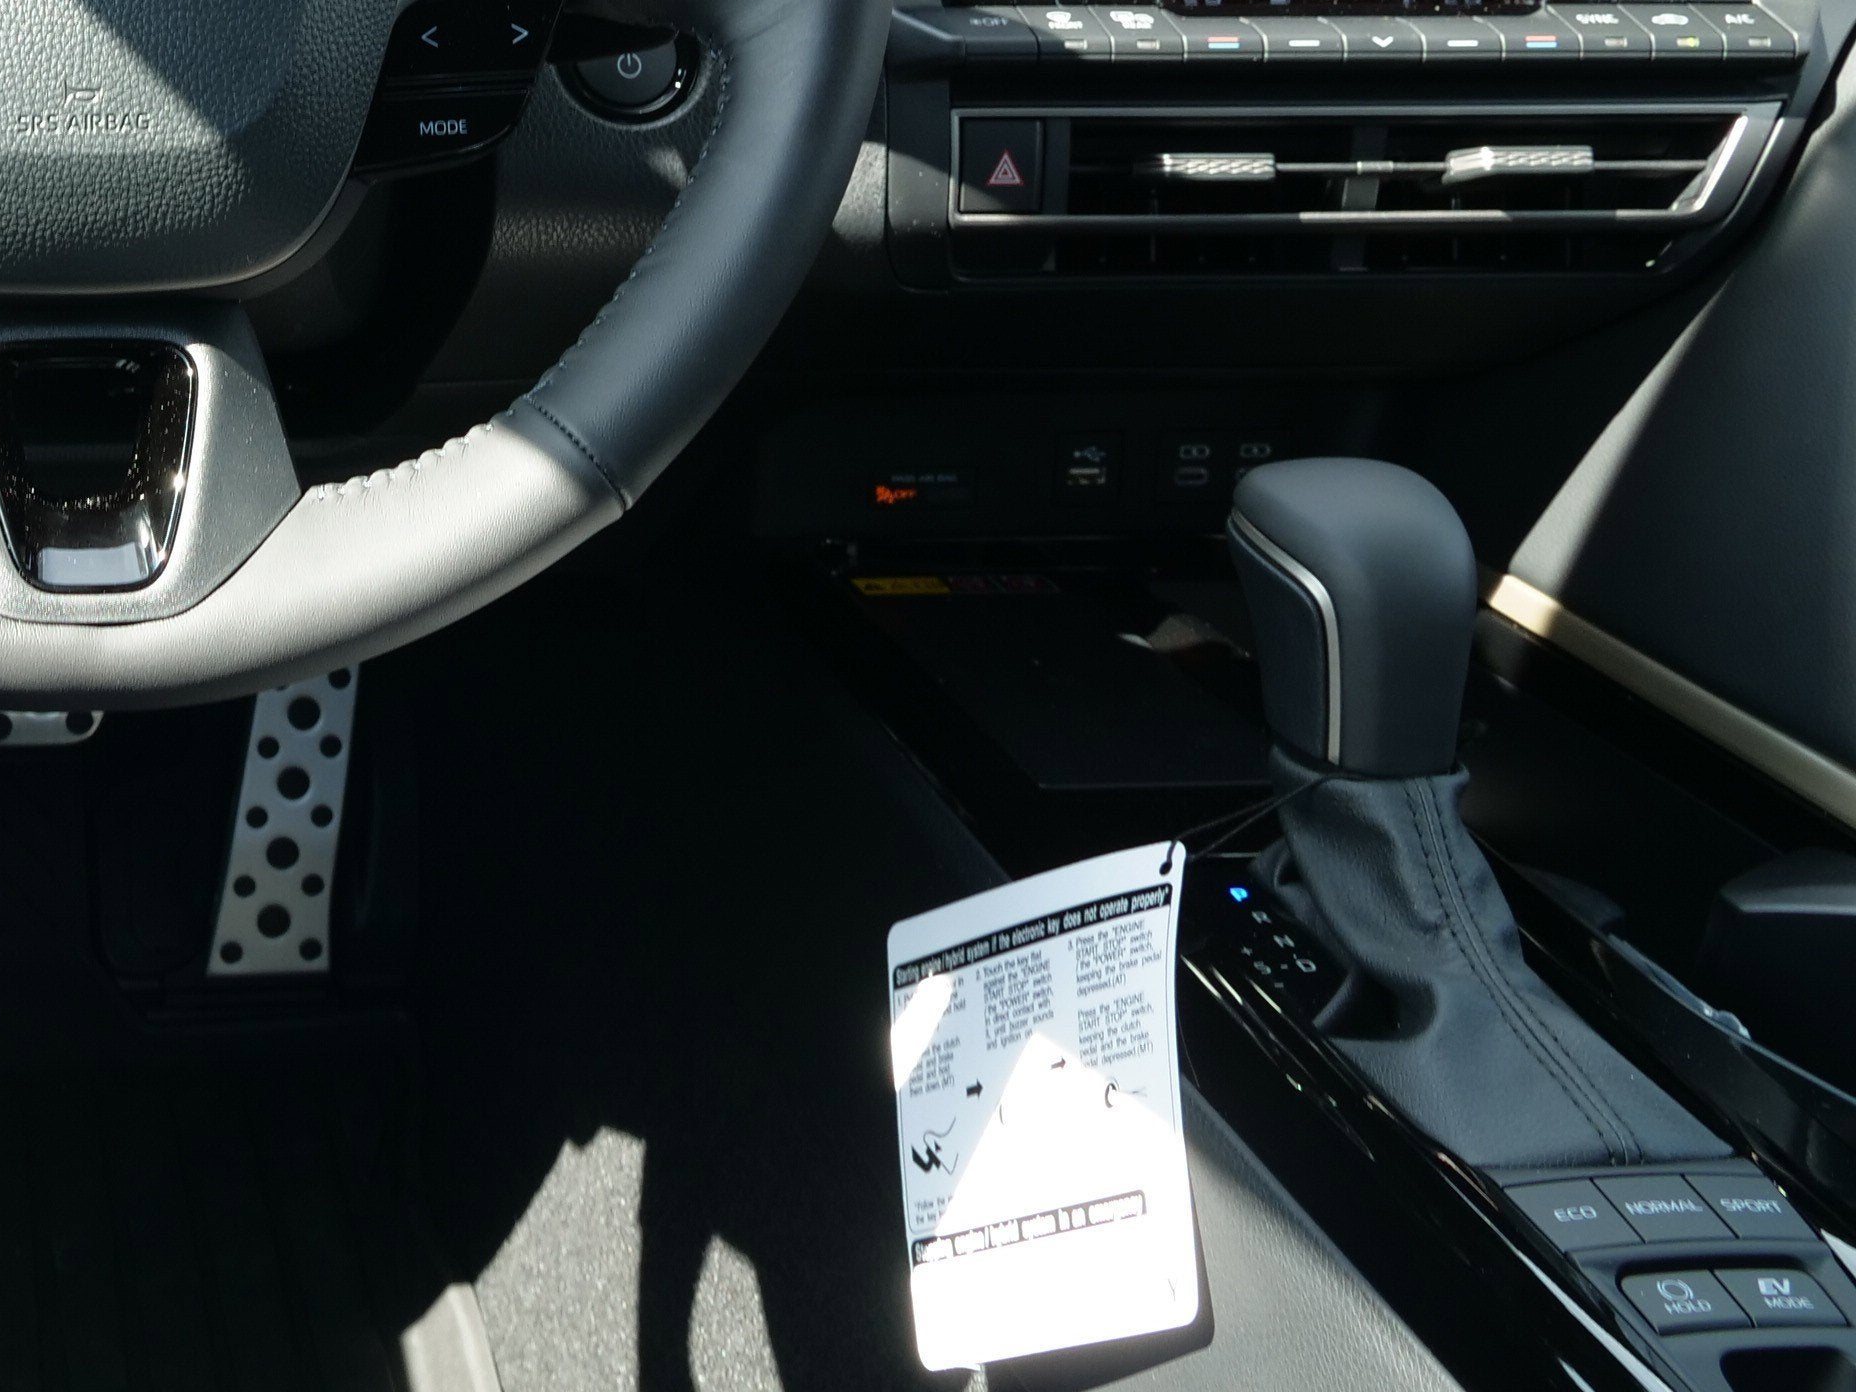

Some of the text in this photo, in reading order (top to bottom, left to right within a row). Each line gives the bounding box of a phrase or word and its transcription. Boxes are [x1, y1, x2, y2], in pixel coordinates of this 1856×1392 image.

[17, 111, 151, 134] SRS AIRBAG
[418, 119, 469, 137] MODE
[895, 964, 919, 987] Starting
[966, 940, 990, 965] system
[998, 933, 1011, 951] the
[1012, 921, 1045, 947] electronic
[1047, 916, 1061, 936] key
[1064, 911, 1082, 929] does
[1084, 906, 1098, 923] not
[1100, 897, 1129, 920] operate
[1075, 934, 1095, 948] Press
[1097, 929, 1109, 941] the
[1075, 945, 1099, 961] START
[1129, 930, 1153, 944] switch
[983, 963, 1004, 978] Touch
[1004, 958, 1016, 970] the
[1016, 954, 1029, 966] key
[1076, 950, 1163, 984] keeping the brake pedal
[1077, 1007, 1097, 1022] Press
[1099, 1003, 1110, 1015] the
[1078, 1017, 1101, 1033] START
[1078, 1019, 1142, 1046] keeping the clutch
[1079, 1030, 1150, 1060] pedal and the brake
[1553, 1205, 1597, 1223] ECO
[1624, 1198, 1704, 1216] NORMAL
[1720, 1197, 1783, 1215] SPORT
[1664, 1298, 1713, 1315] HOLD
[1763, 1296, 1815, 1310] MODE
